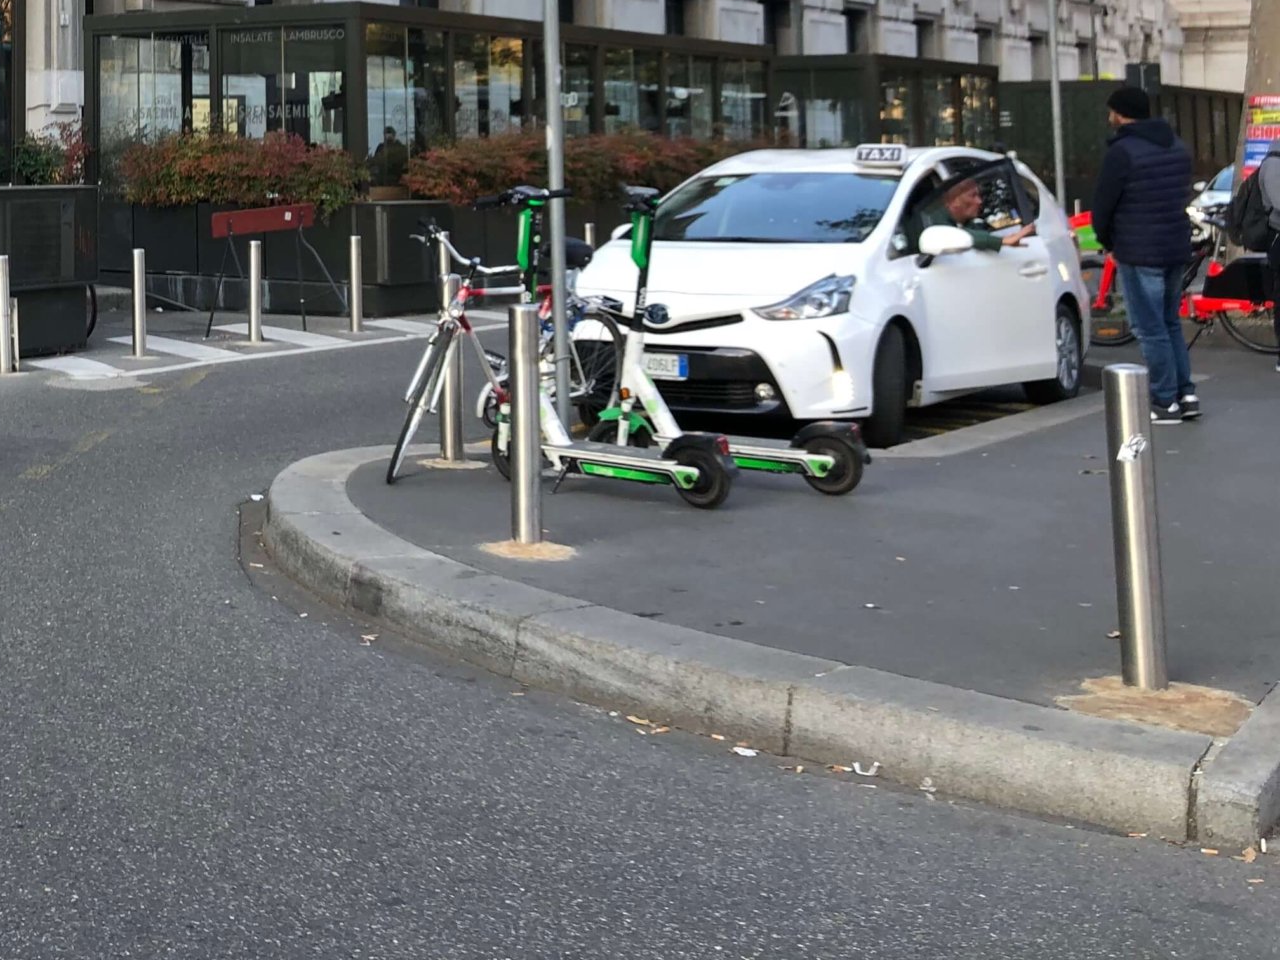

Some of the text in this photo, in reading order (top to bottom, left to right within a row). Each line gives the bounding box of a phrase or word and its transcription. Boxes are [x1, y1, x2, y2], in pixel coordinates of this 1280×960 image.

[230, 31, 273, 44] INSALATE
[284, 29, 345, 41] LAMBRUSCO
[861, 148, 898, 161] TAXI
